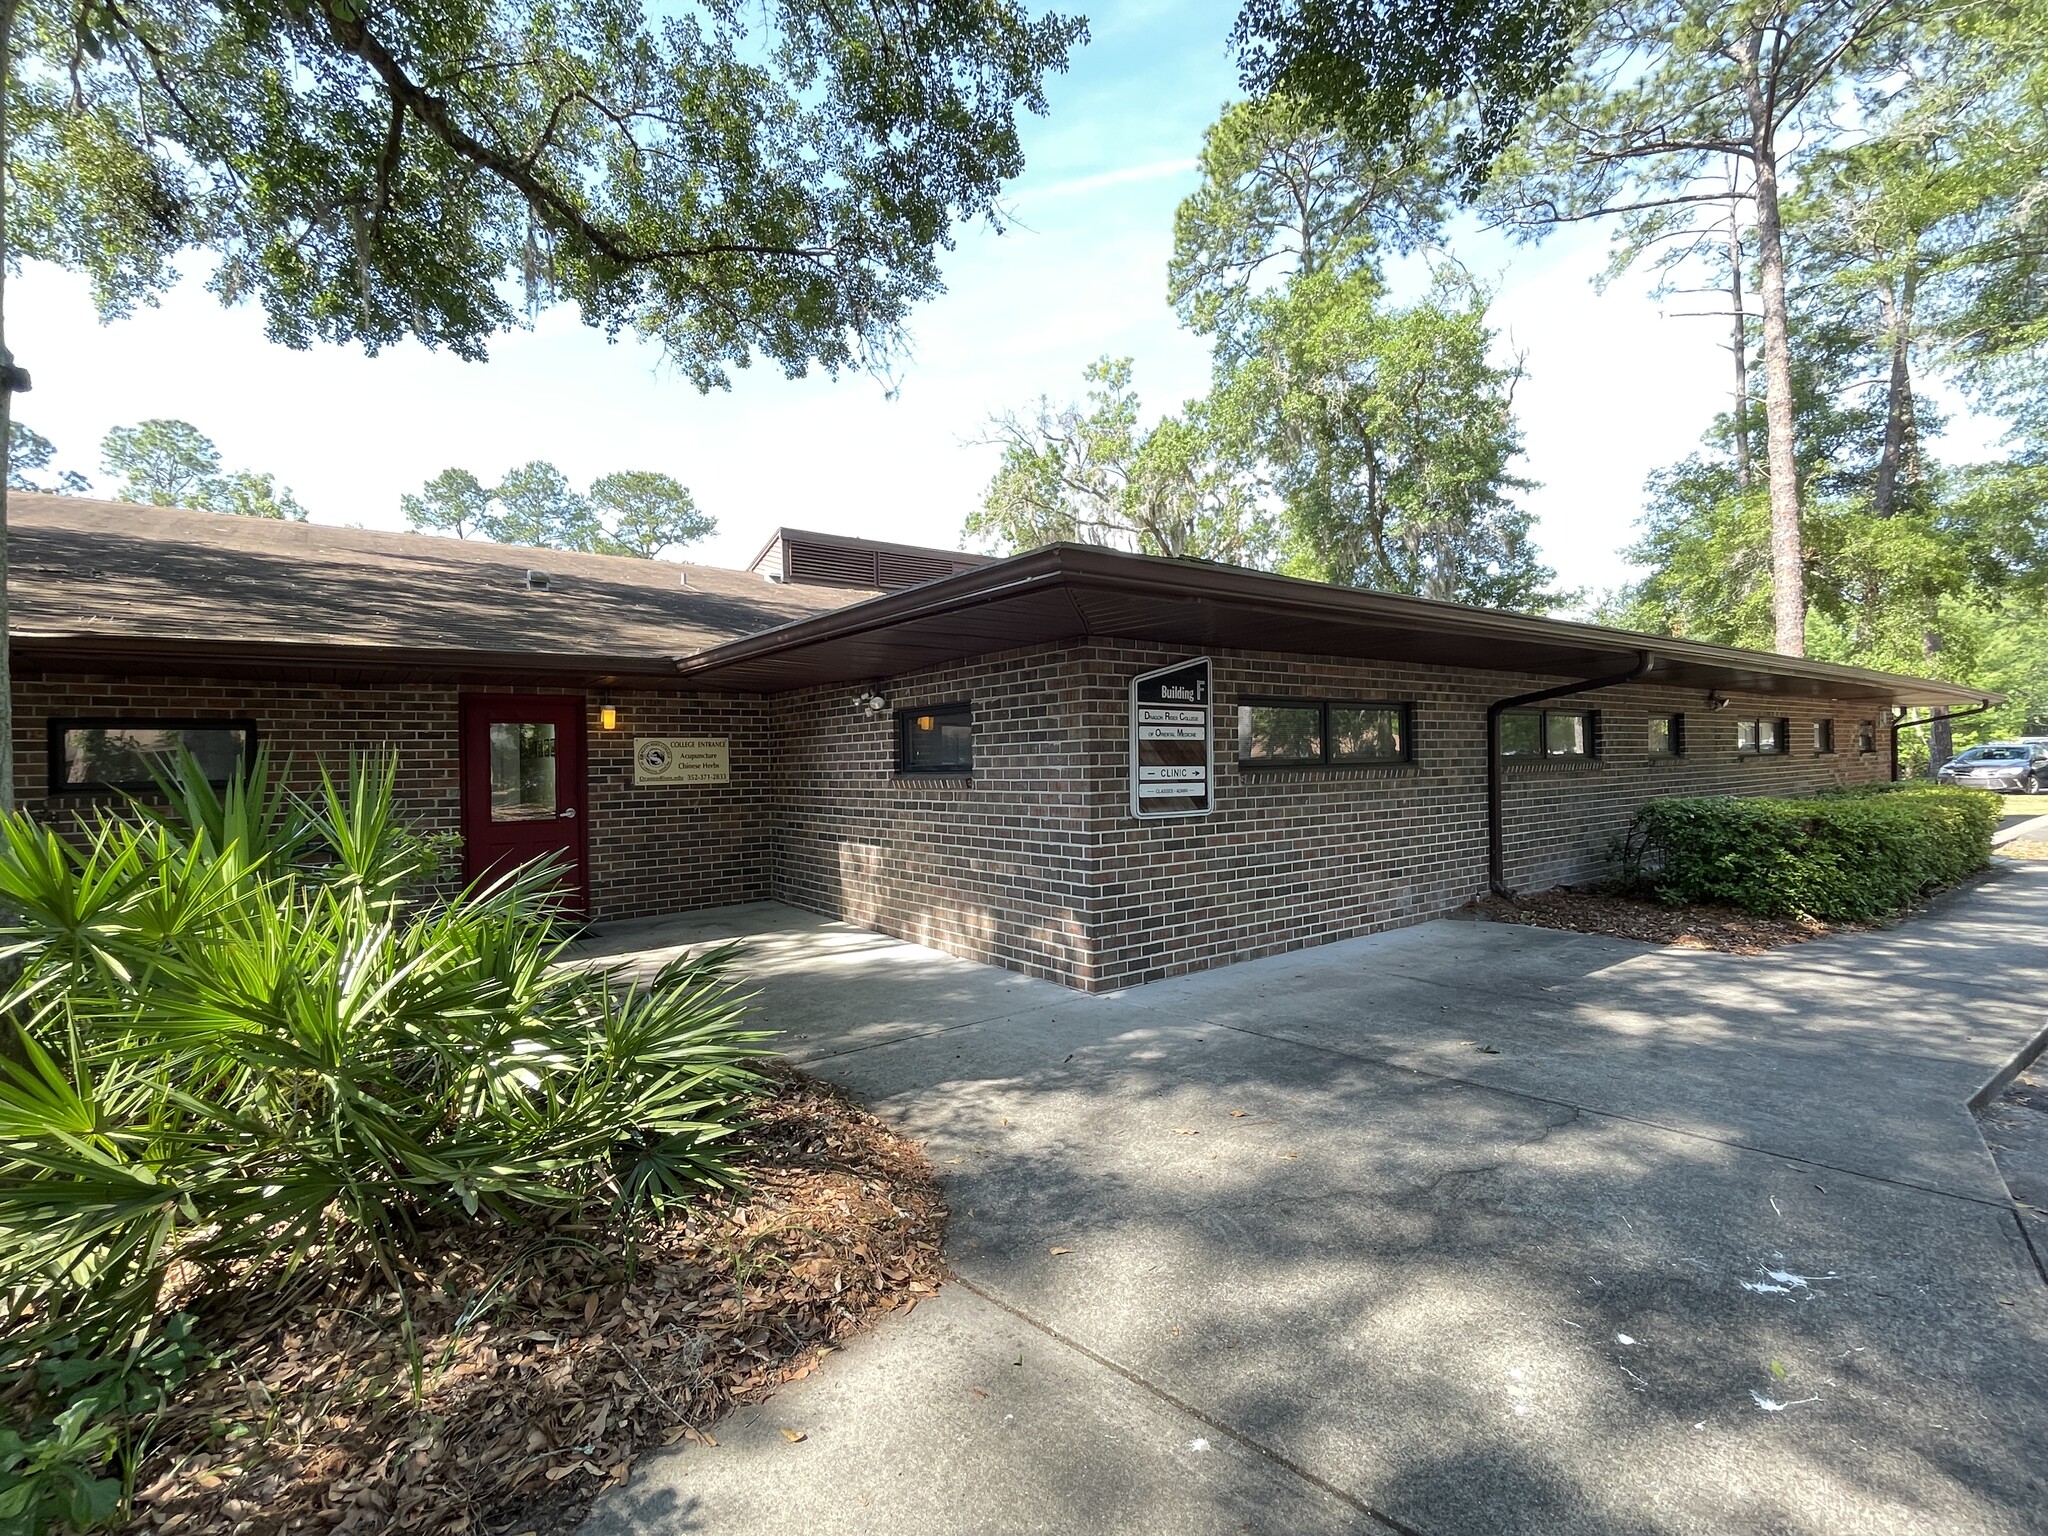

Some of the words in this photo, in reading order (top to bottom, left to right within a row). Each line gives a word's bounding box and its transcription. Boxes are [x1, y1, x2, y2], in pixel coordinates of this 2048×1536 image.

[1161, 685, 1194, 702] Building
[1196, 680, 1205, 700] F
[1180, 713, 1198, 721] COLLEGE
[1155, 729, 1176, 737] ORIENTAL
[1177, 729, 1196, 738] MEDICINE
[1161, 769, 1187, 777] CLINIC
